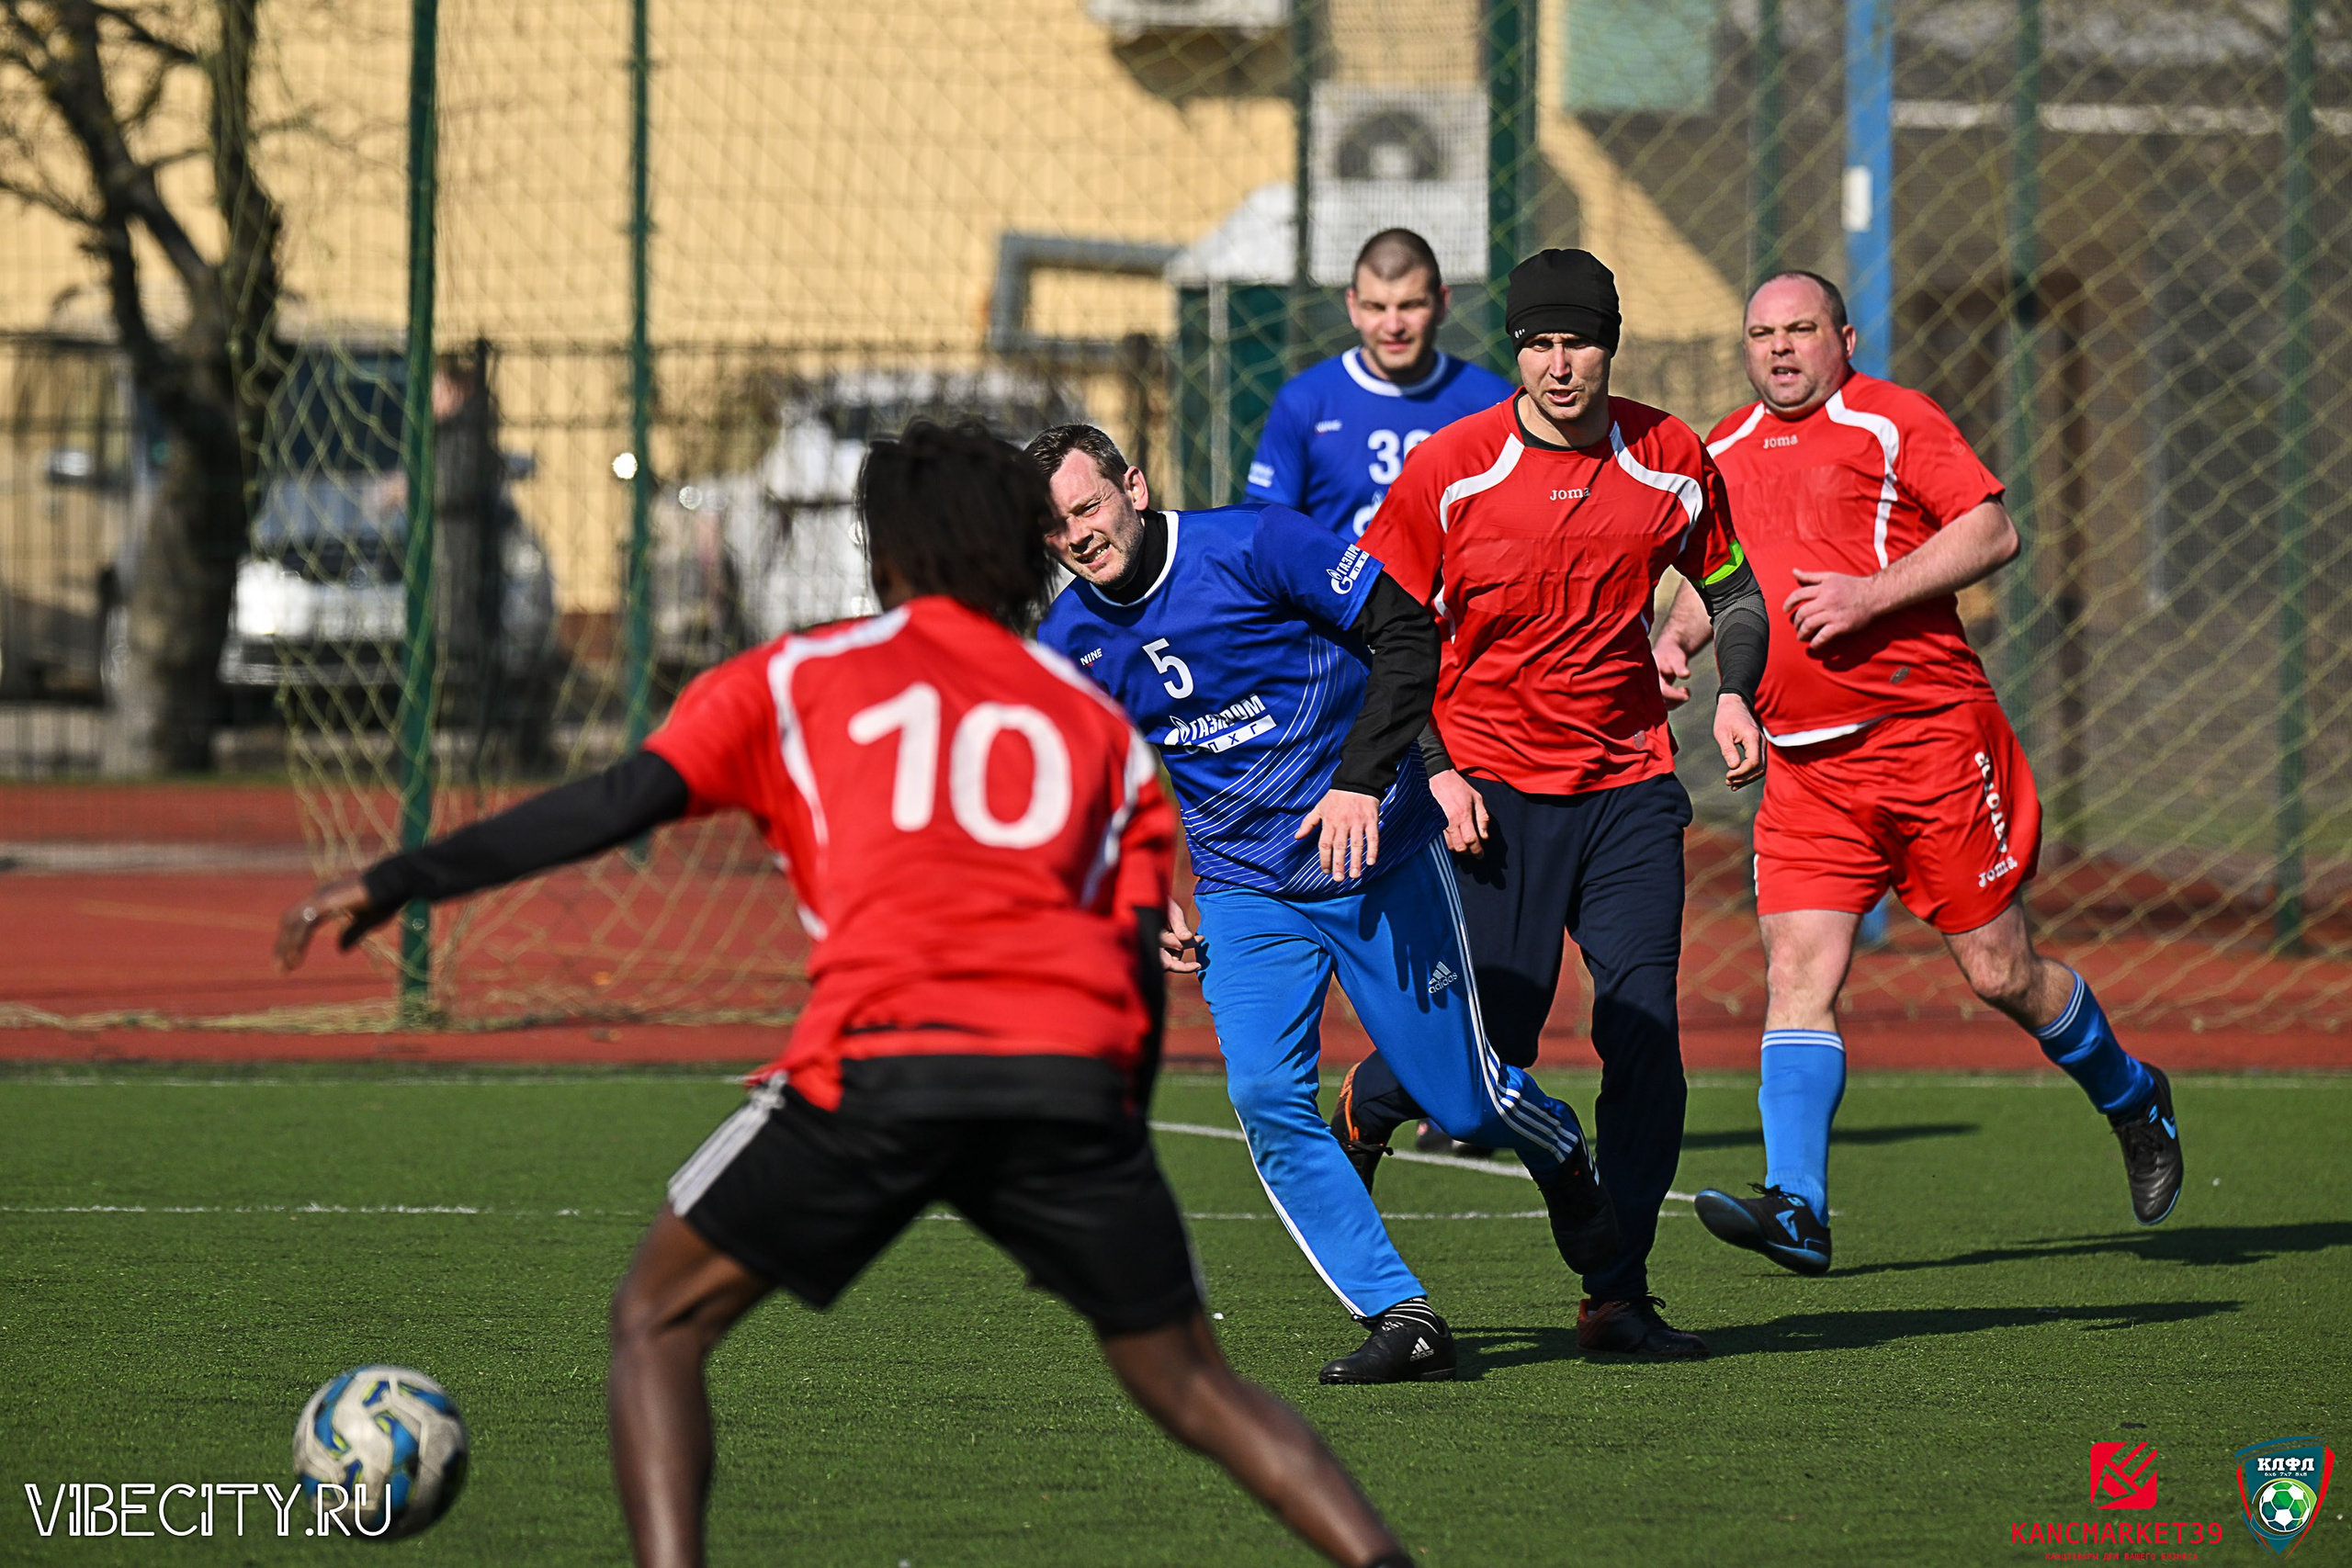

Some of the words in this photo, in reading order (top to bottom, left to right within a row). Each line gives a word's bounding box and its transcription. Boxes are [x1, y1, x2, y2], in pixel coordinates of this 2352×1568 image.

[1080, 648, 1102, 666] NINE
[1142, 637, 1193, 699] 5
[848, 682, 1072, 849] 10
[1429, 972, 1458, 994] adidas
[1410, 1348, 1434, 1361] adidas
